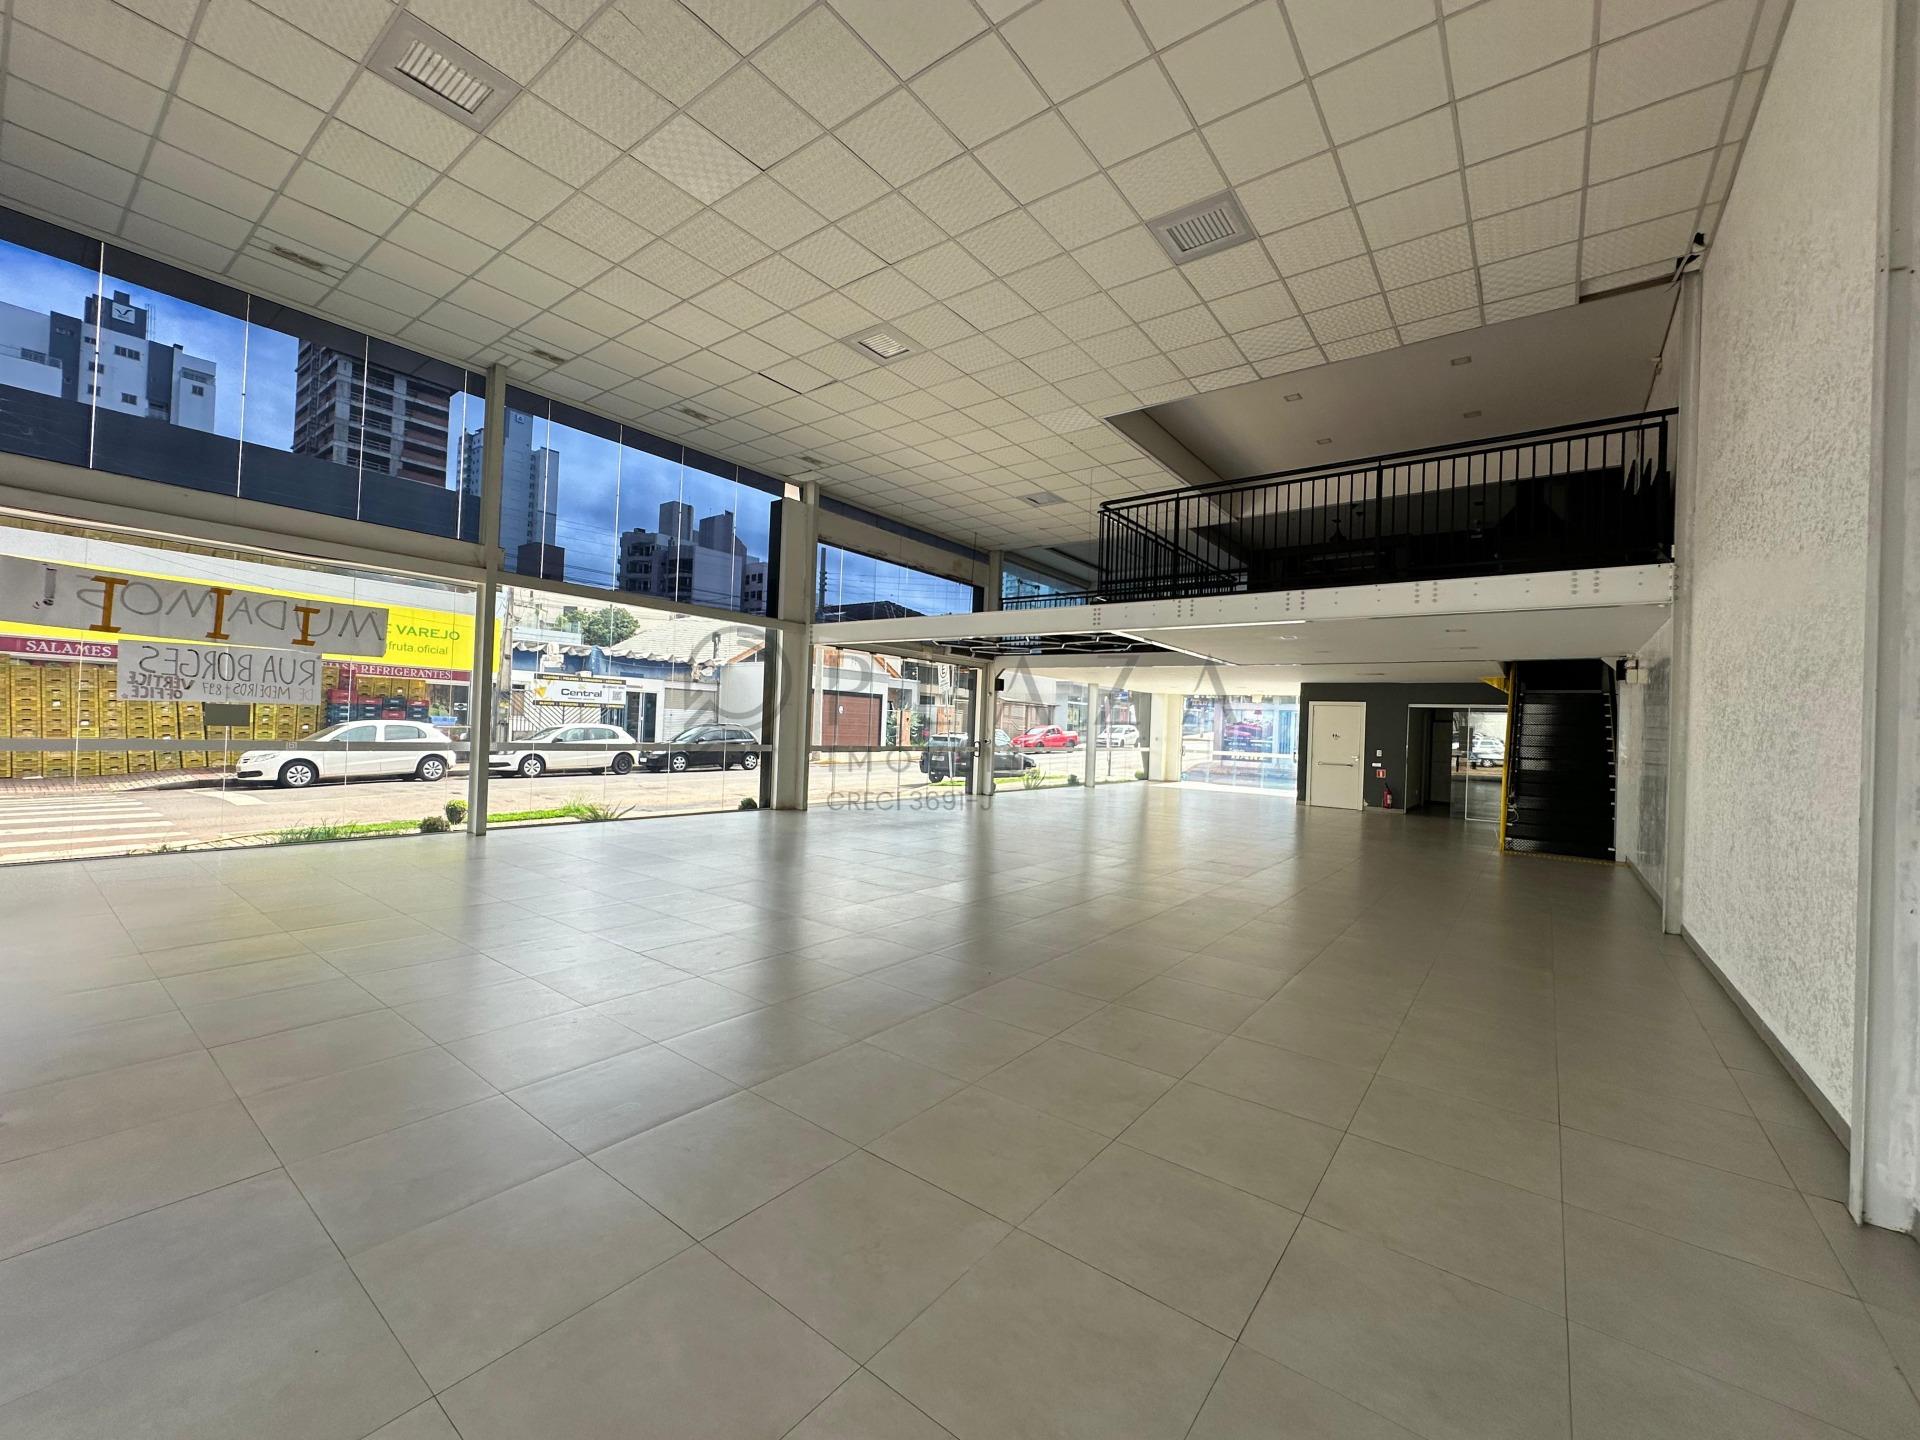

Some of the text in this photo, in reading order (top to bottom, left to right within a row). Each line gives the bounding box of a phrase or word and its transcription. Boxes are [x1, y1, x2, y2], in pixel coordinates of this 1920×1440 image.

[396, 623, 460, 641] VAREJO
[25, 640, 112, 658] SALAMES
[361, 664, 452, 680] REFRIGERANTES
[560, 688, 603, 698] Central
